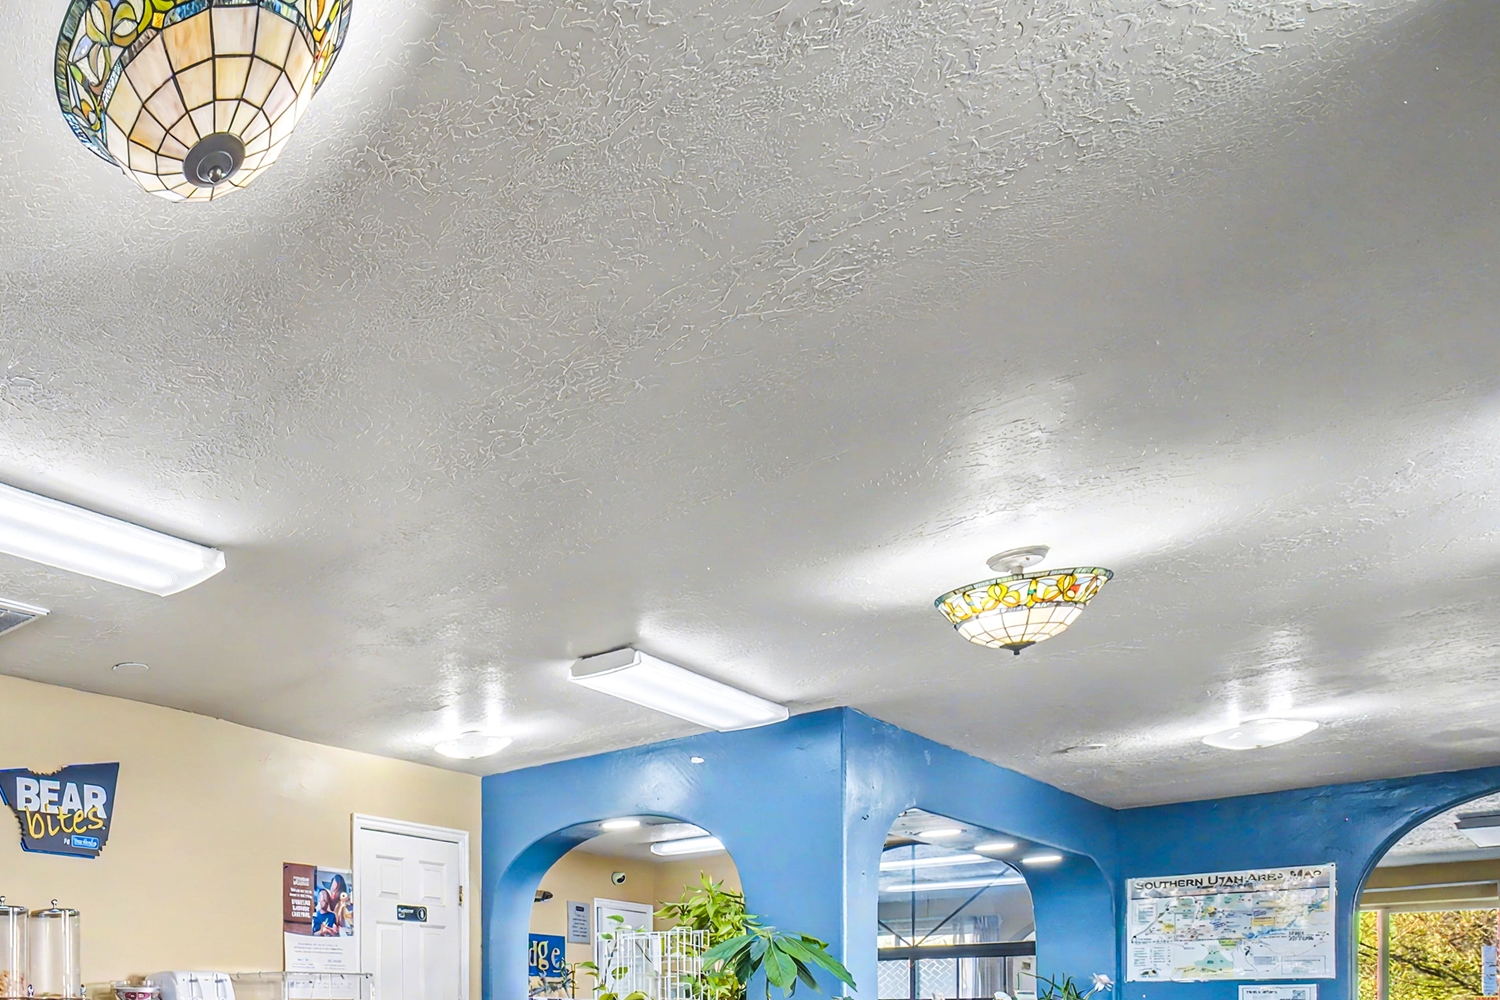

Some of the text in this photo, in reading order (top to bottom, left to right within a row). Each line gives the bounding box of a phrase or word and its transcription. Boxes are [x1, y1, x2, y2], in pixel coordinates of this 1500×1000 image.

[16, 776, 107, 819] BEAR
[25, 803, 104, 839] bites
[1133, 874, 1203, 891] SOUTHERN
